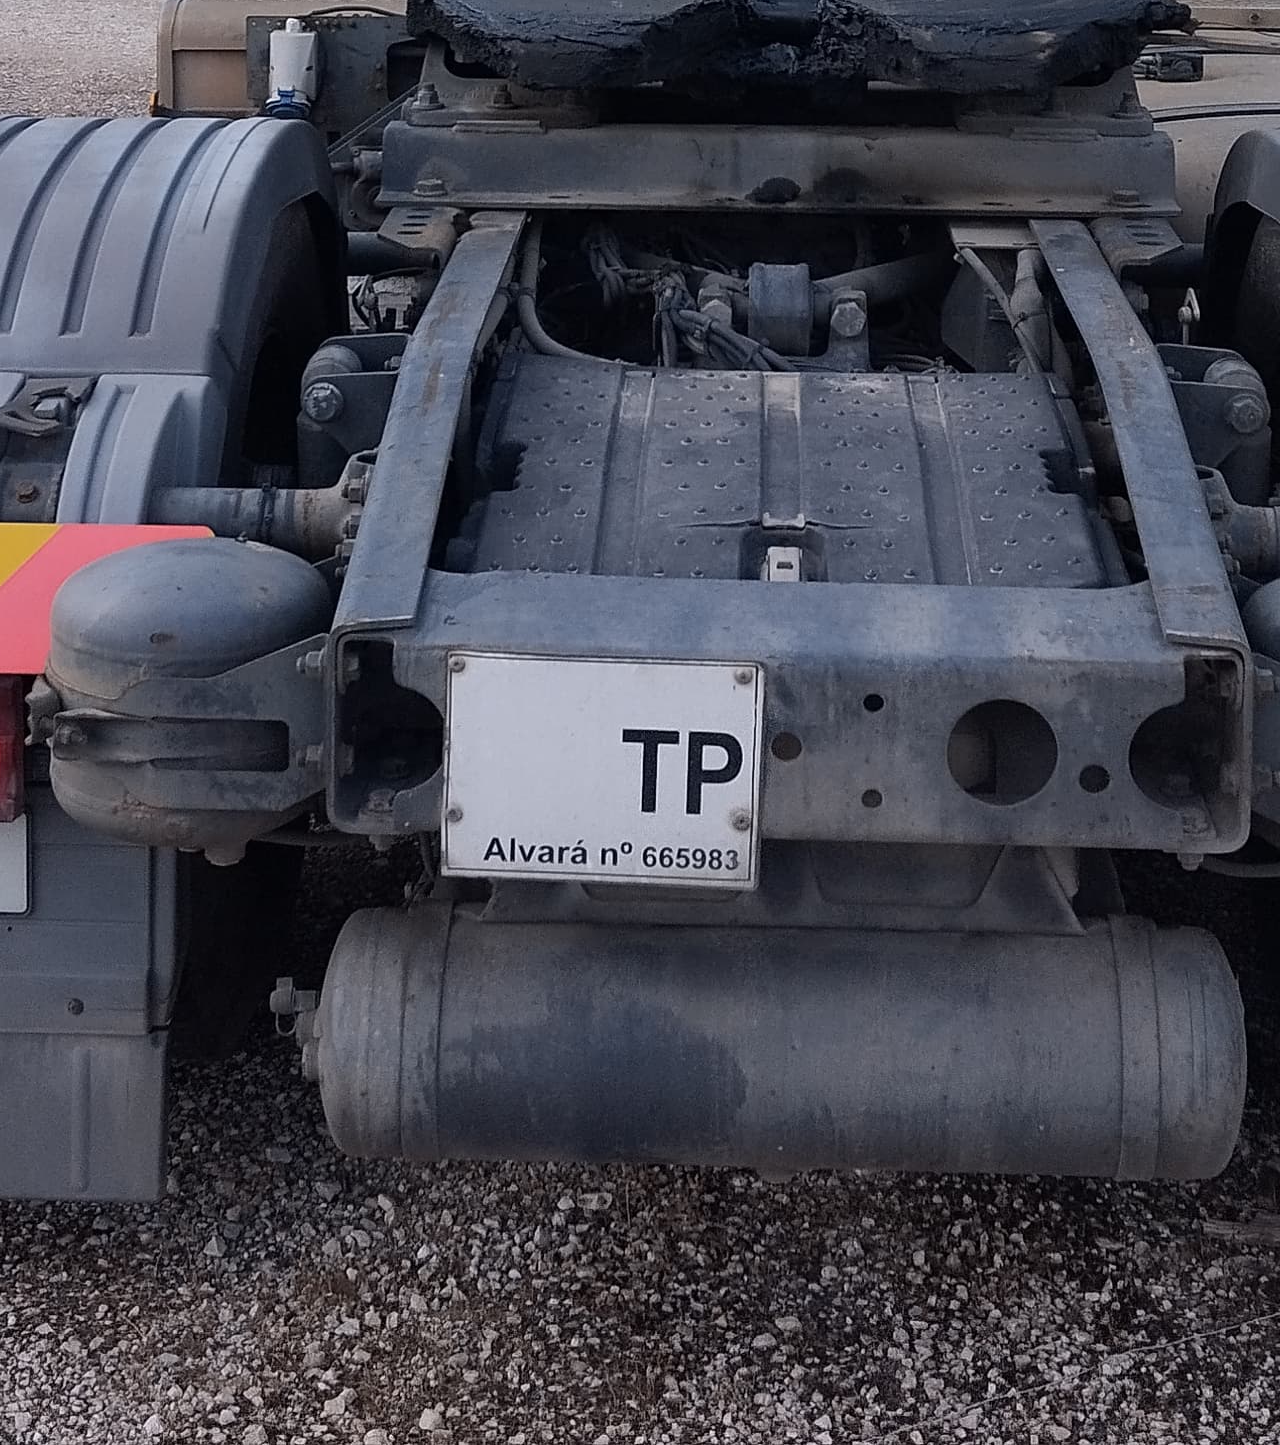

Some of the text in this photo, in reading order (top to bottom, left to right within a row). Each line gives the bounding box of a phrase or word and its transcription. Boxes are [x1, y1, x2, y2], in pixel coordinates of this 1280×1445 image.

[622, 729, 743, 815] TP
[483, 837, 588, 866] Alvará
[642, 846, 739, 871] 665983
